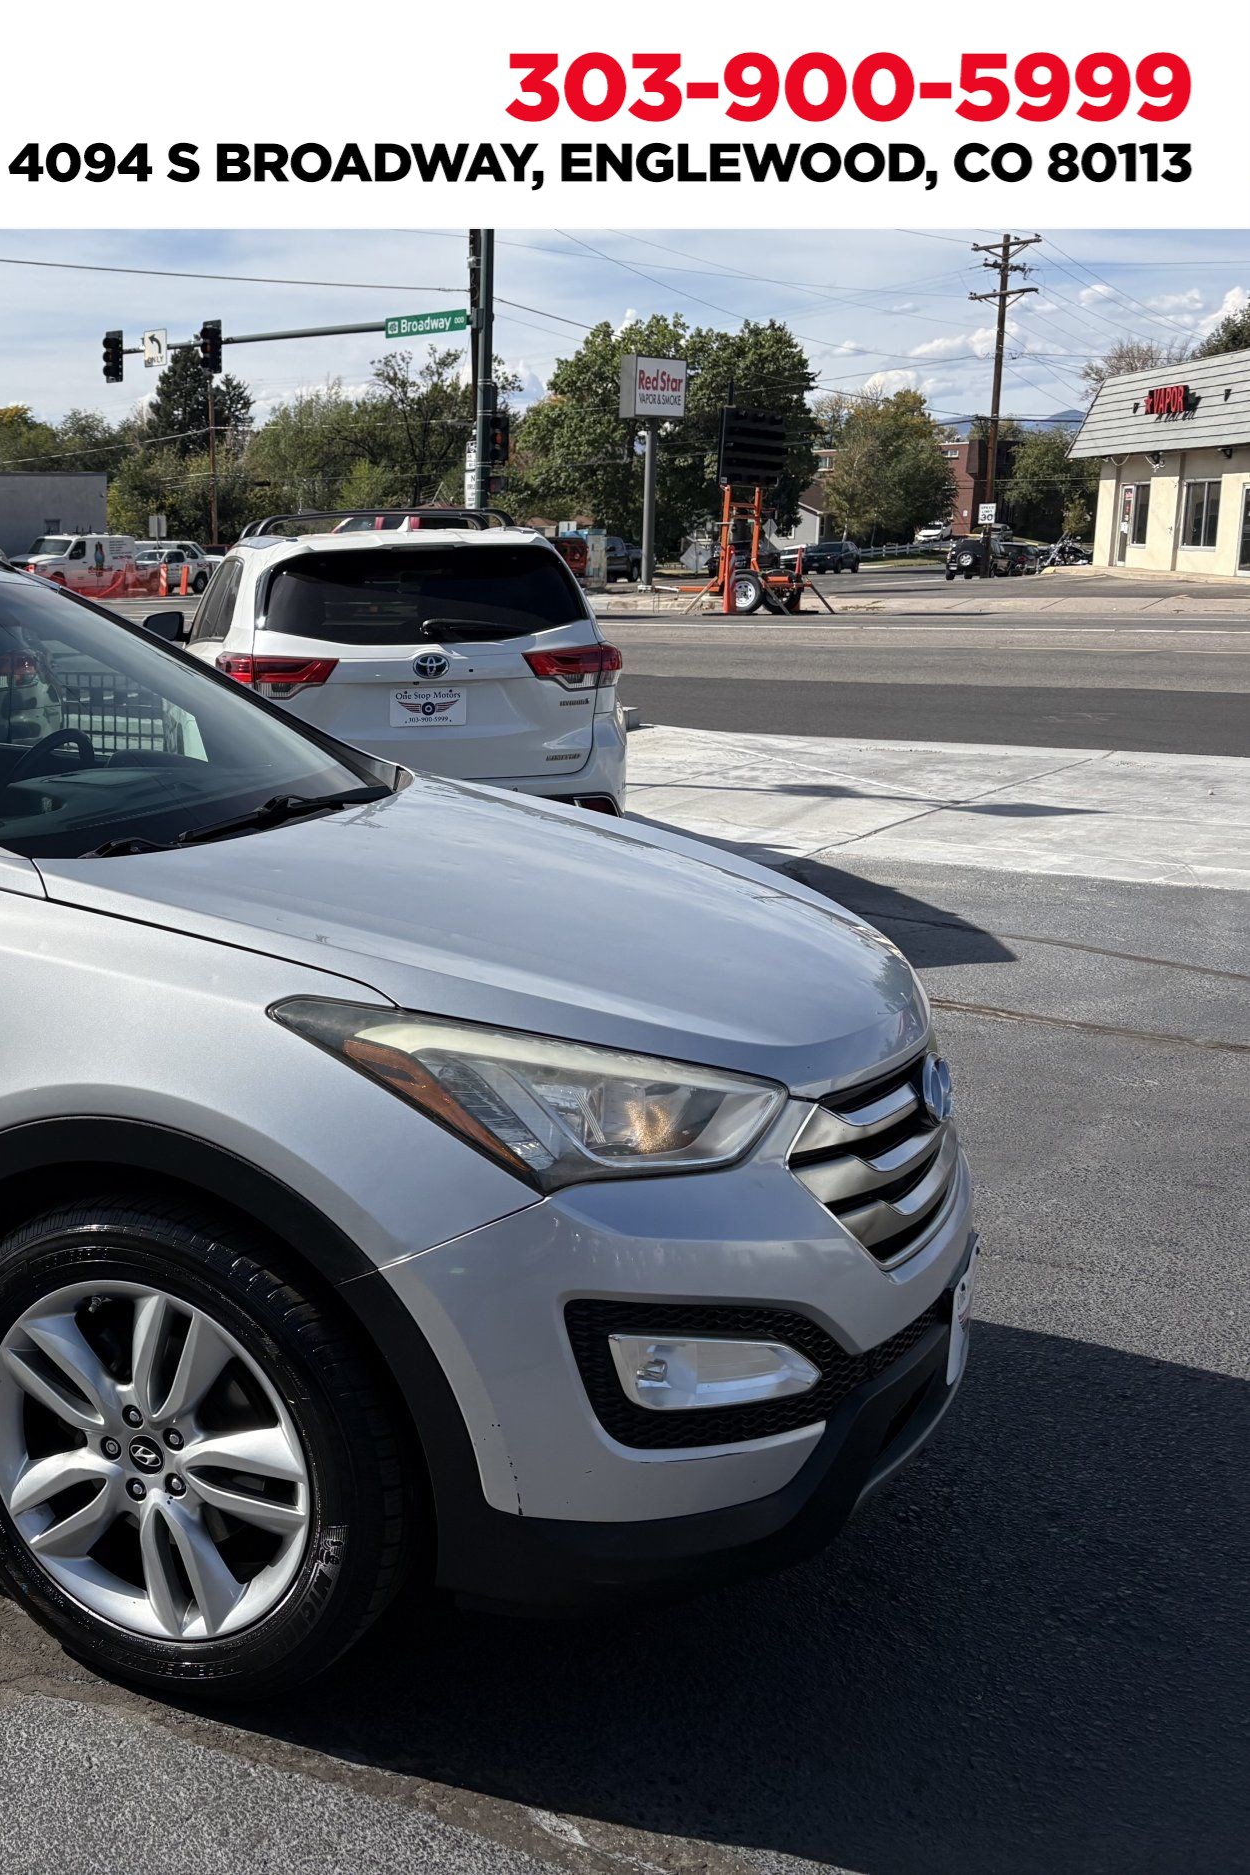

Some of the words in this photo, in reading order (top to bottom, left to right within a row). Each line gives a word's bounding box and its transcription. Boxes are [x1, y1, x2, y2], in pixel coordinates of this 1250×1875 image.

[401, 316, 451, 333] Broadway
[638, 369, 659, 391] Red
[660, 371, 683, 392] Star
[1153, 384, 1184, 414] VAPOR
[395, 691, 412, 700] One
[413, 691, 431, 700] Stop
[433, 690, 461, 699] Motors
